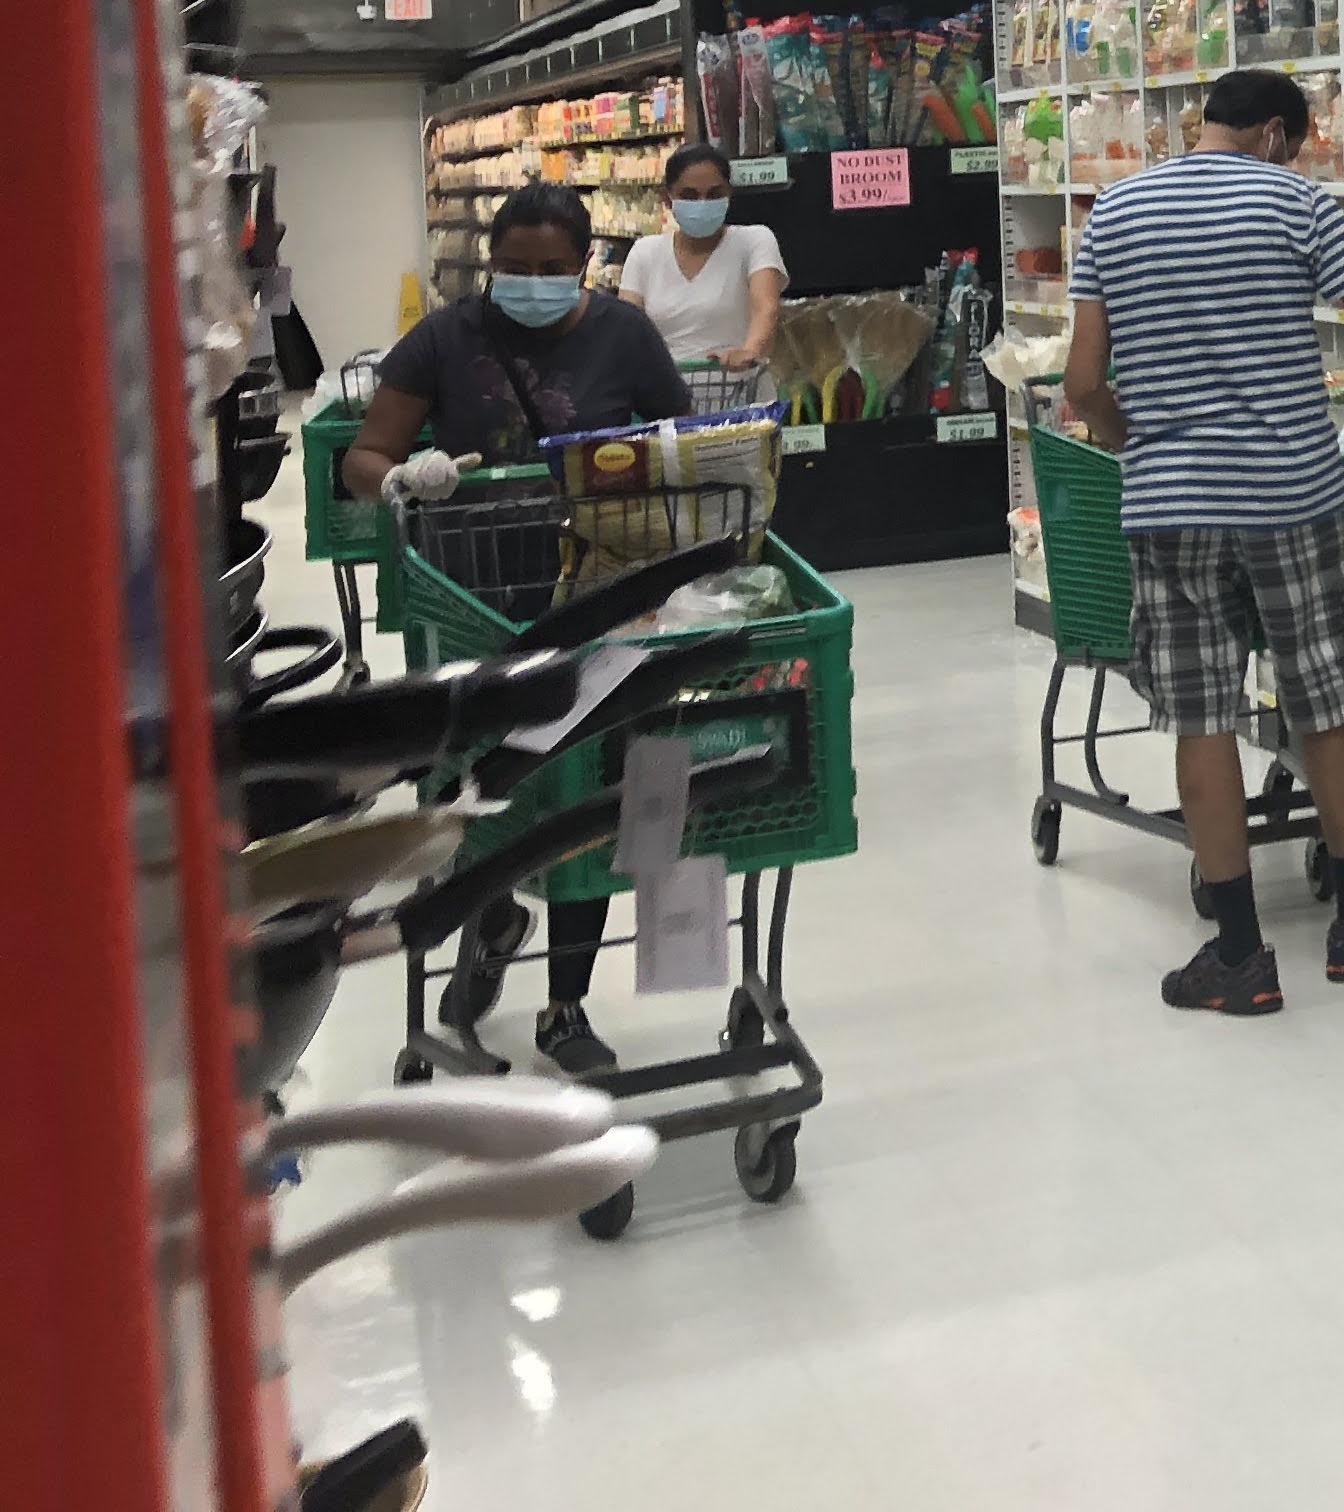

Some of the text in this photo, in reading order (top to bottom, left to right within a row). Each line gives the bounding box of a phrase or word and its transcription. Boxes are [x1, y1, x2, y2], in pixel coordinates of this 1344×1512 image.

[837, 154, 902, 168] NO DUST
[839, 170, 902, 186] BROOM
